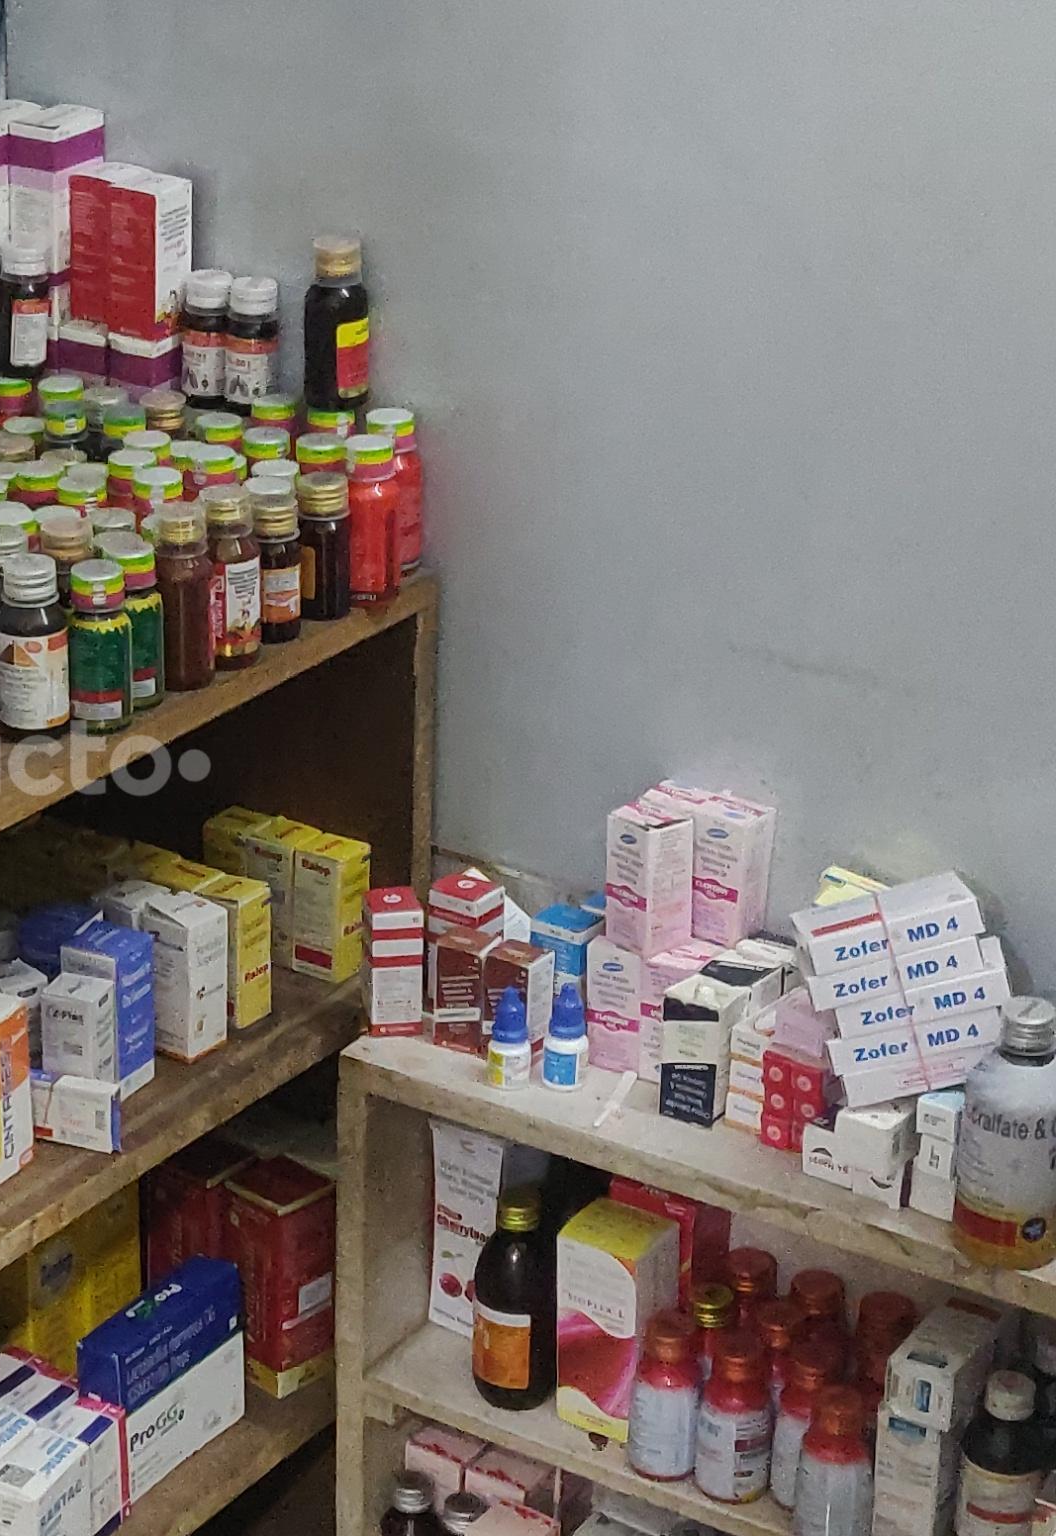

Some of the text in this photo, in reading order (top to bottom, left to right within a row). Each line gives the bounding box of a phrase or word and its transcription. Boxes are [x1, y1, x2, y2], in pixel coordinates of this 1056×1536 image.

[834, 916, 959, 962] Zofer MD 4
[833, 955, 959, 999] Zofer MD 4
[861, 986, 986, 1026] Zofer MD 4
[853, 1023, 979, 1062] Zofer MD 4
